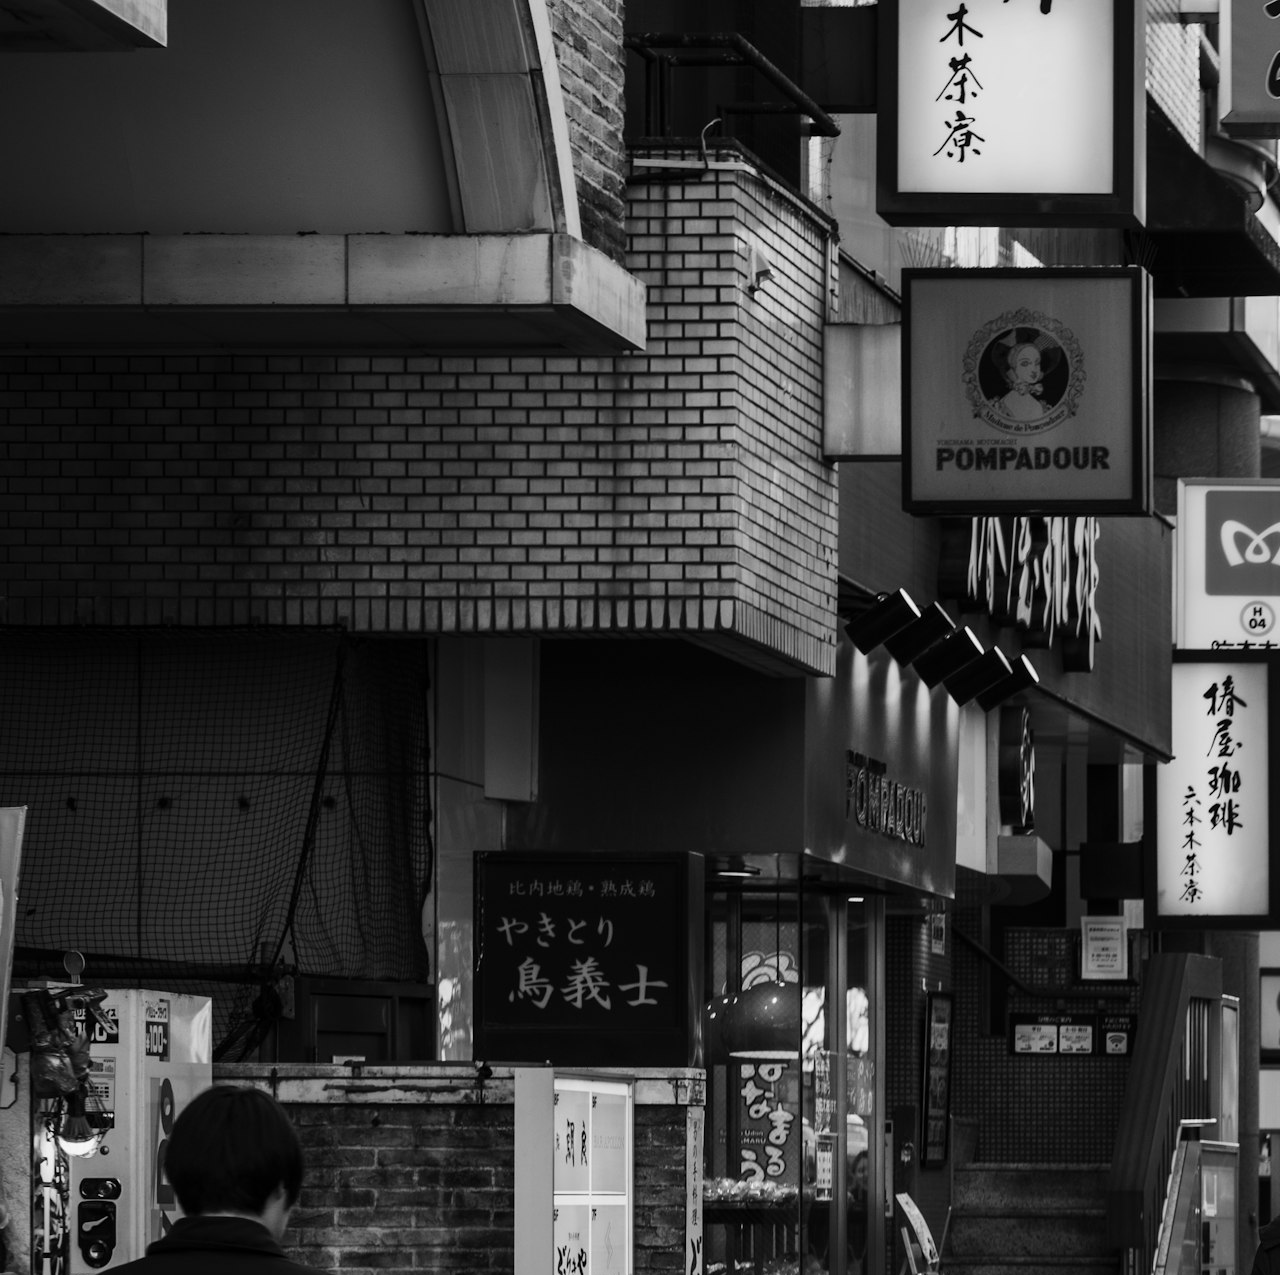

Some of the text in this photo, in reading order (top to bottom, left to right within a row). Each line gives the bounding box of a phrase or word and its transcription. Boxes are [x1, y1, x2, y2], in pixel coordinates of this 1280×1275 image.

[1013, 423, 1024, 432] de
[936, 446, 1110, 471] POMPADOUR
[1249, 618, 1267, 629] 04
[1253, 606, 1263, 617] H
[1203, 674, 1247, 836] 椿屋珈琲
[1179, 785, 1203, 905] 六本木茶寮
[496, 911, 614, 948] やきとり
[508, 955, 669, 1011] 鳥義士
